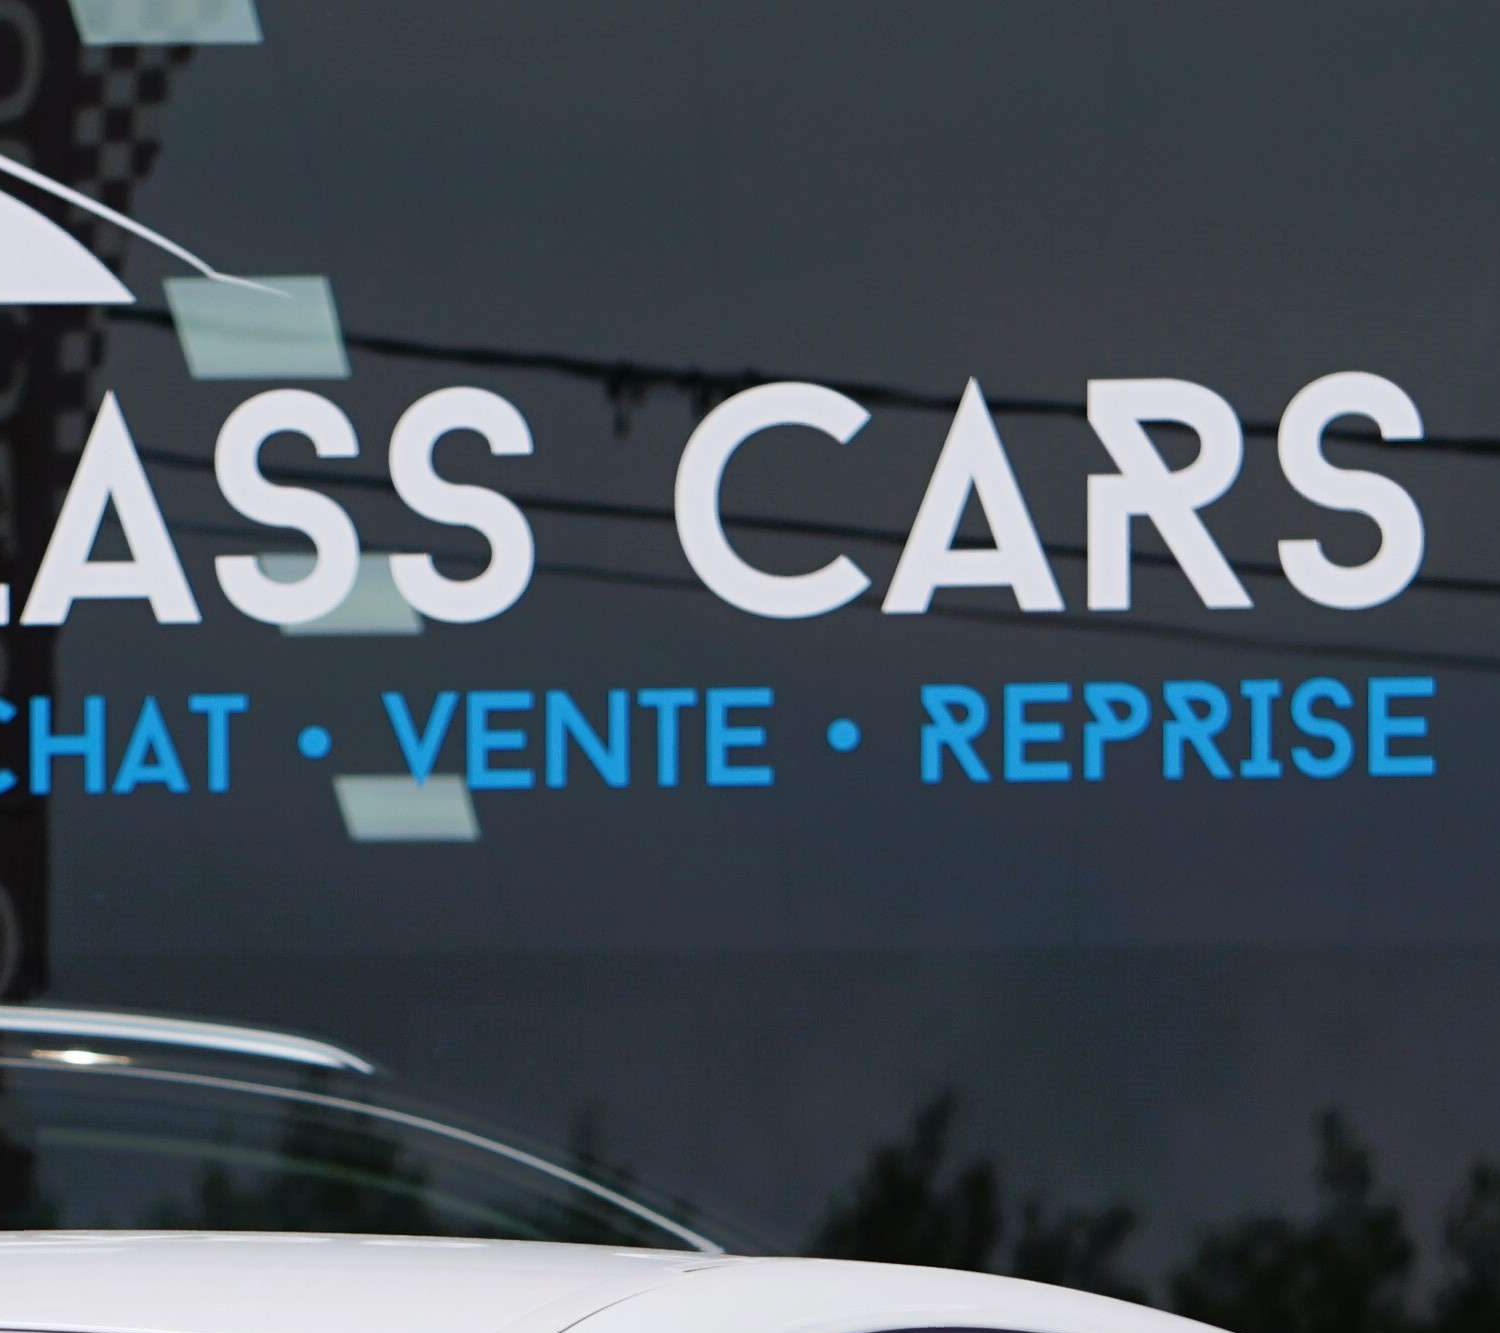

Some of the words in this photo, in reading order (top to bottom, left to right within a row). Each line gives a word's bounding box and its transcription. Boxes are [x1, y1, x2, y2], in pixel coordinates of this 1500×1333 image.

[674, 371, 1424, 618] CARS
[382, 687, 776, 791] VENTE
[920, 677, 1437, 785] REPRISE
